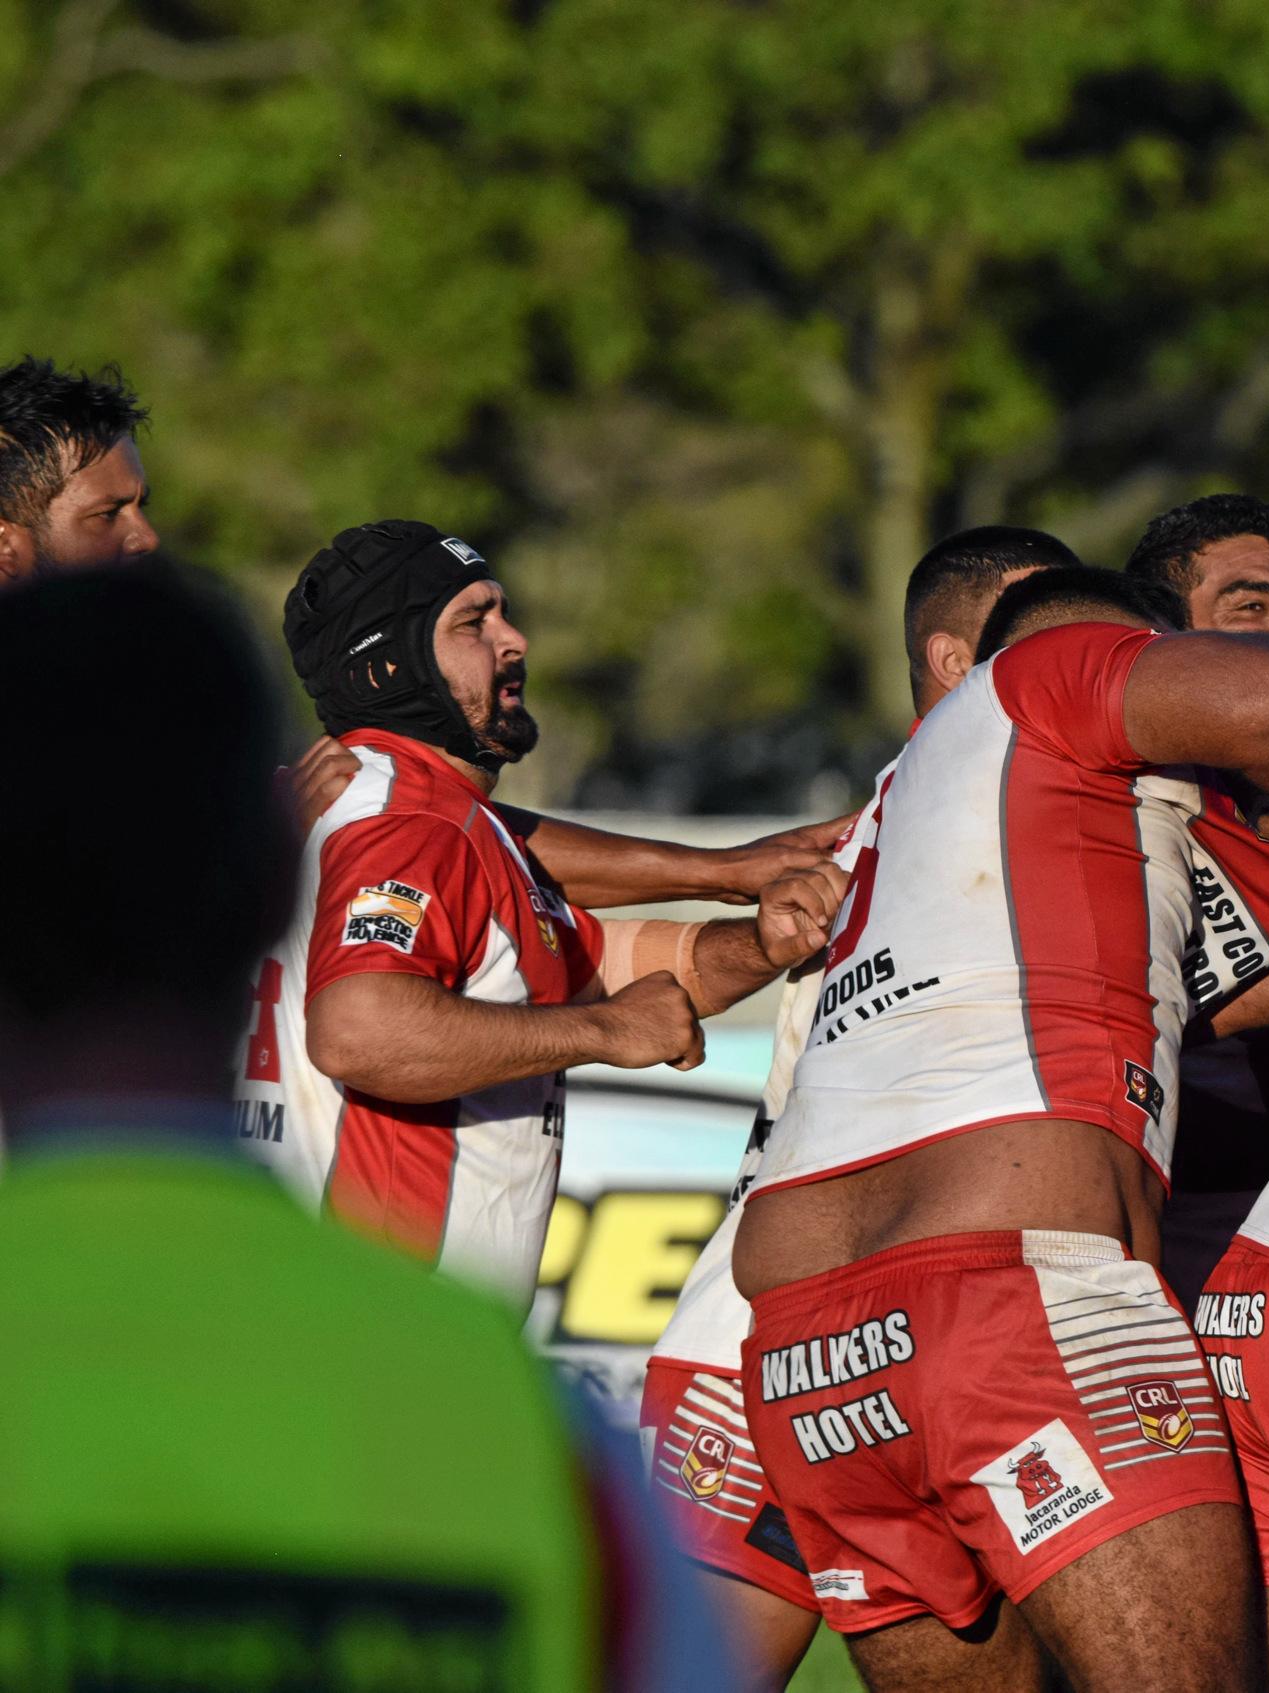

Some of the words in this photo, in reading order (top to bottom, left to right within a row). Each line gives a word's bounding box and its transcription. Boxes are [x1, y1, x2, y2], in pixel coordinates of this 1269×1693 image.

[1192, 866, 1247, 934] EAST
[1222, 936, 1268, 985] CO
[760, 1310, 915, 1403] WALKERS
[792, 1388, 912, 1464] HOTEL
[1135, 1387, 1178, 1408] CRL
[1020, 1513, 1062, 1547] MOTOR
[1062, 1487, 1104, 1519] LODGE
[1025, 1484, 1082, 1527] Jacaranda
